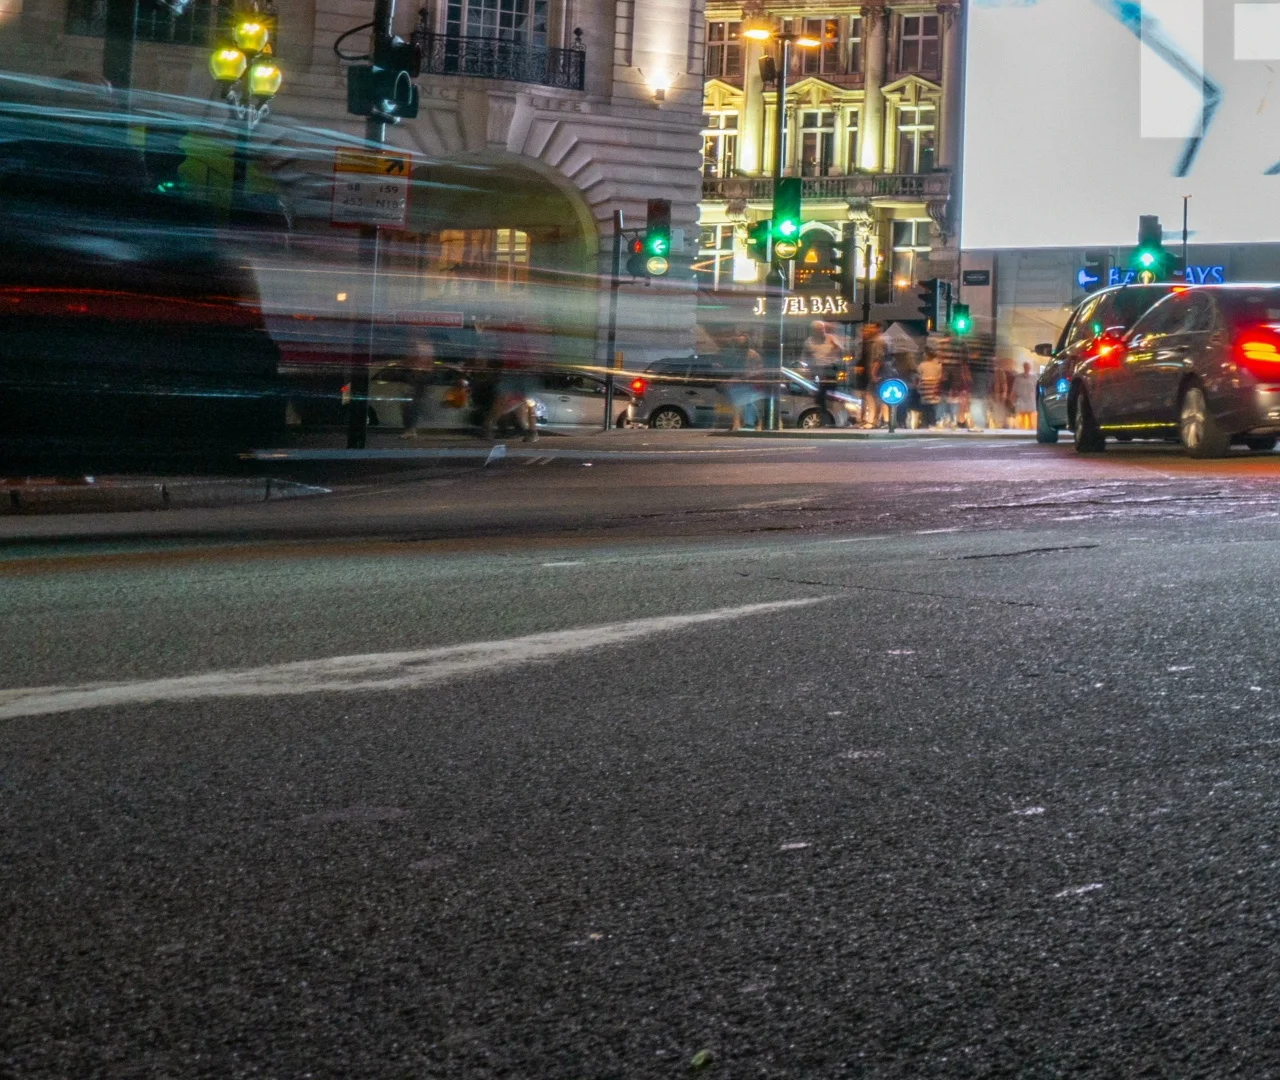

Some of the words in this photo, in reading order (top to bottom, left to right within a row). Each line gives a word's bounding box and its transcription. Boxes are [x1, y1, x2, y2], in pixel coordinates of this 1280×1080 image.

[1109, 266, 1225, 284] BAYS
[752, 296, 808, 315] JEL
[810, 296, 849, 314] BAR
